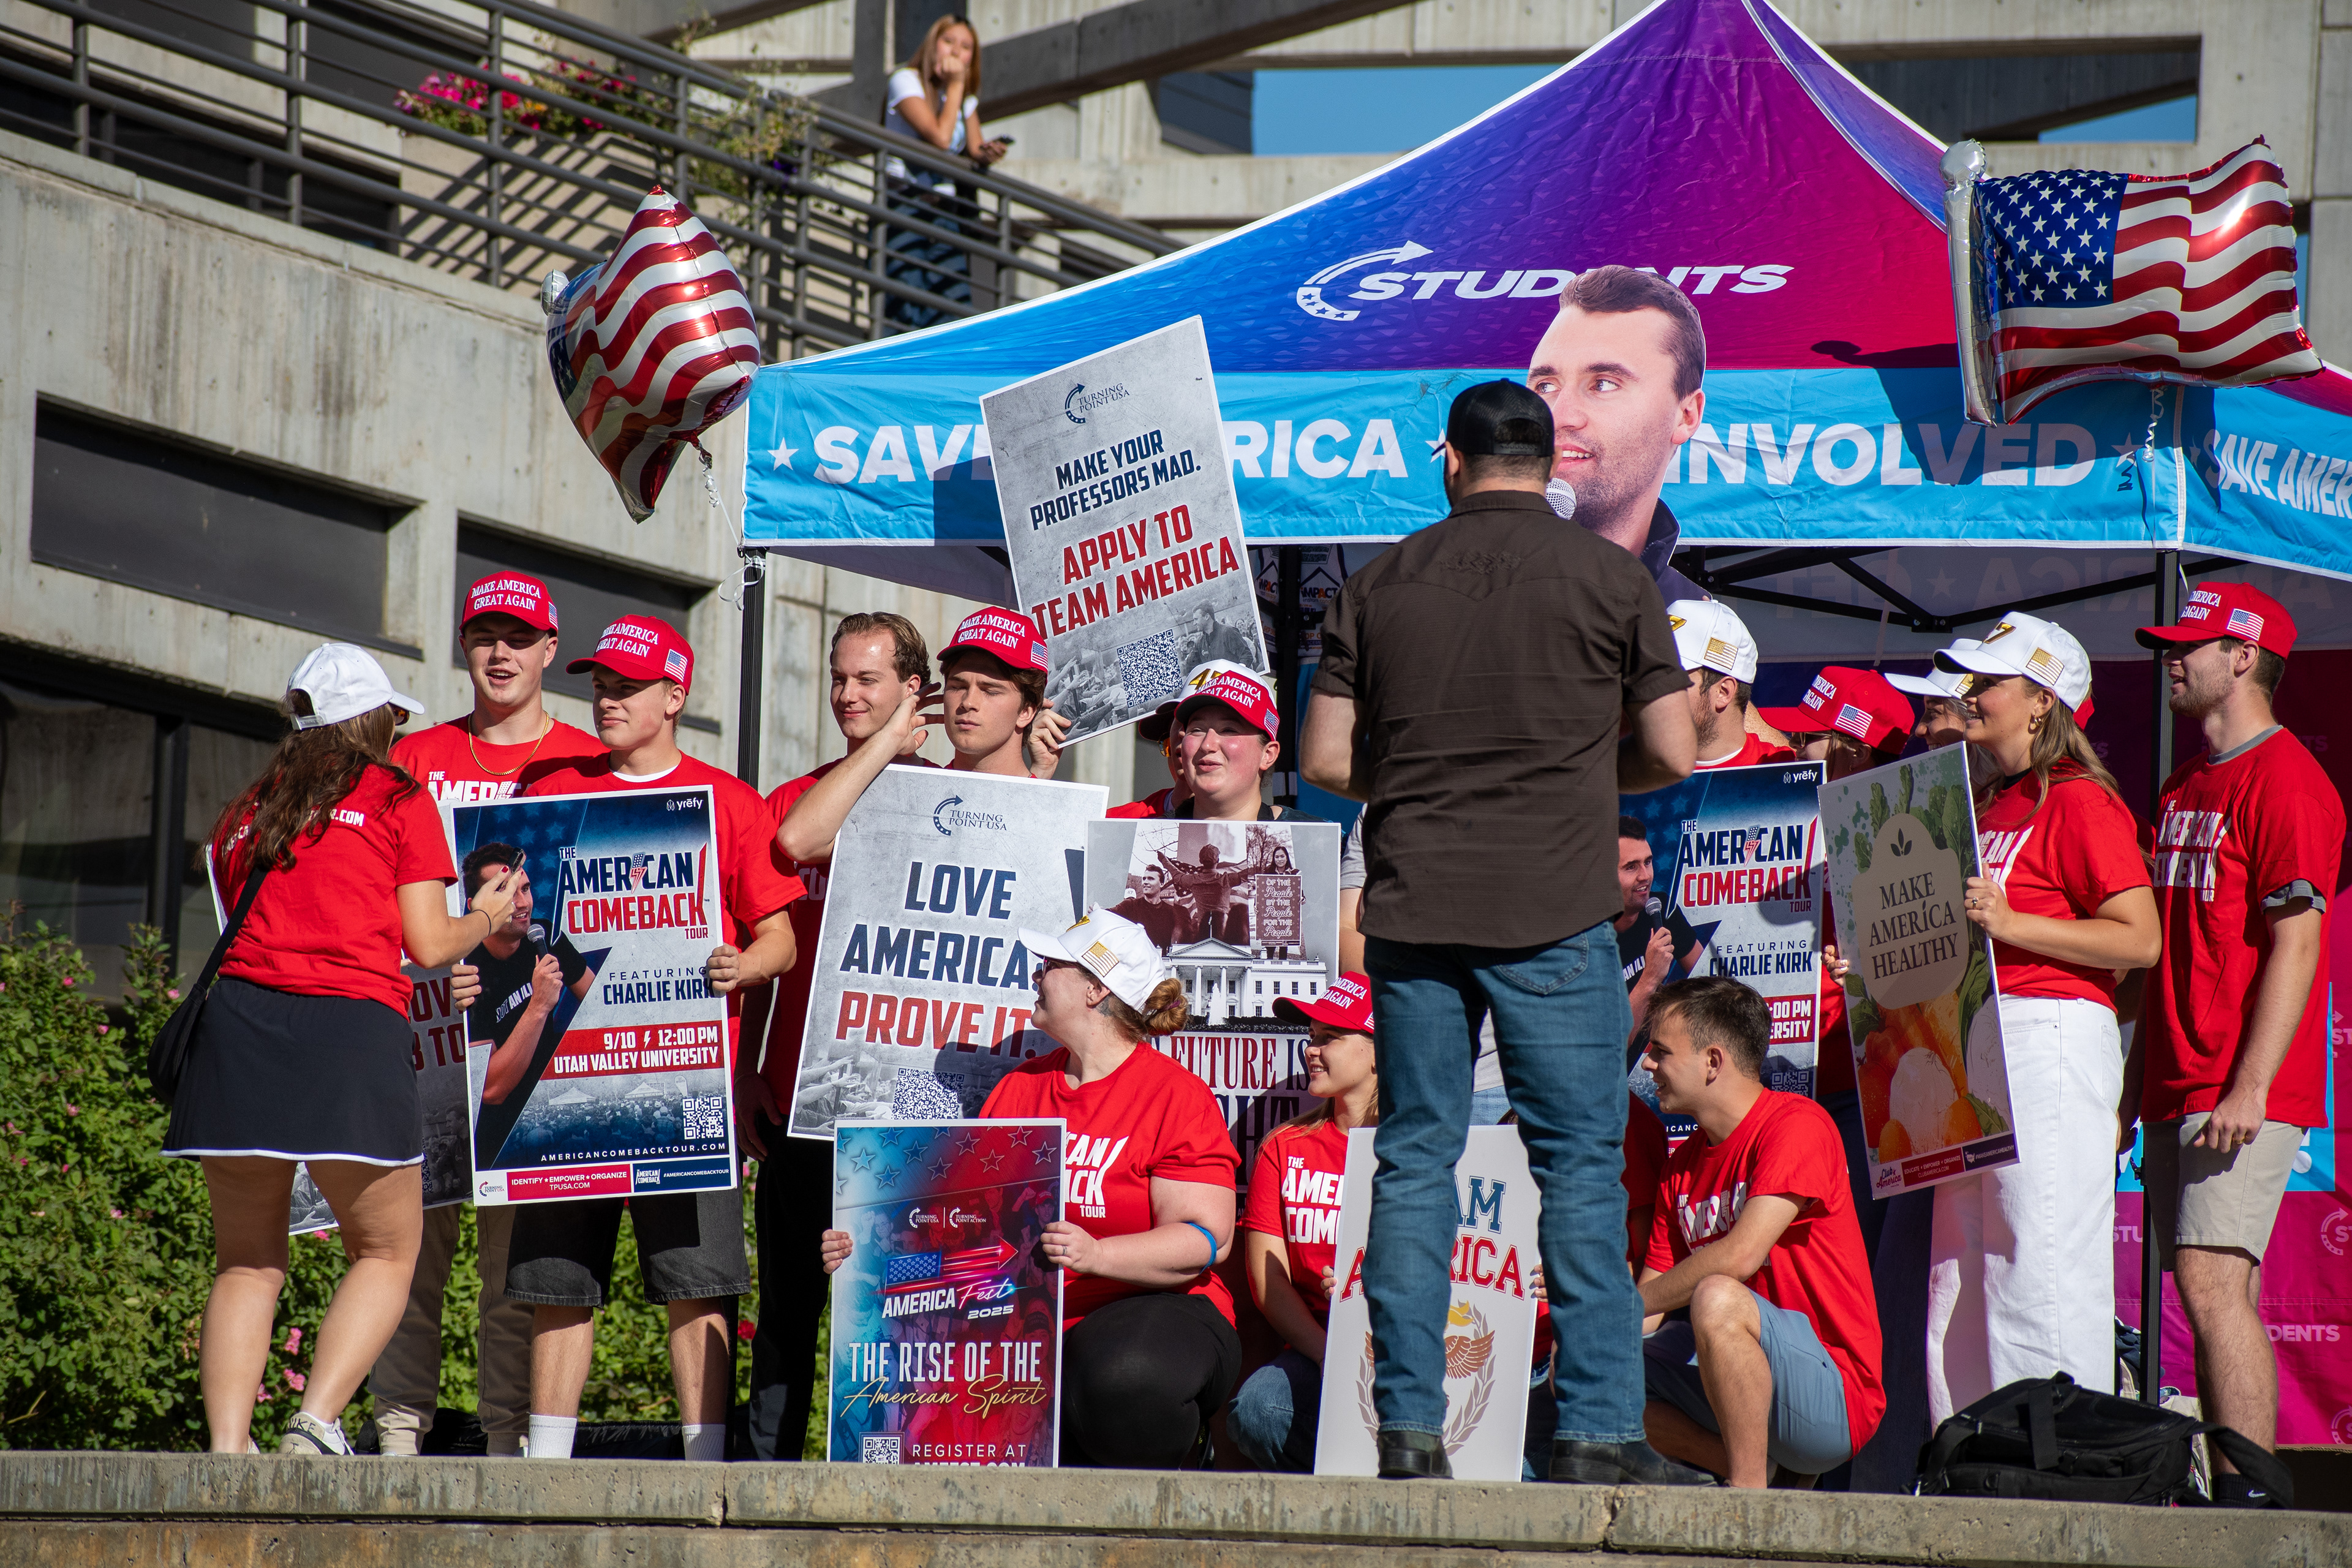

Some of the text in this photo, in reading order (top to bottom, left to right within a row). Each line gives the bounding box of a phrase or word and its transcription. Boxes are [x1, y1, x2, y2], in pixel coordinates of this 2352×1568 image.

[1348, 265, 1794, 301] STUDTS
[1077, 383, 1123, 405] TURNING
[1079, 389, 1130, 414] POINT USA
[1222, 418, 1408, 479] RICA
[1055, 429, 1164, 490] MAKE YOUR
[2203, 429, 2278, 501] SAVE
[1030, 449, 1201, 531] PROFESSORS MAD.
[1064, 505, 1193, 586] APPLY TO
[471, 579, 541, 599] MAKE AMERICA
[1031, 536, 1240, 640] TEAM AMERICA
[473, 594, 536, 611] GREAT AGAIN
[613, 624, 658, 645] AMERICA
[959, 614, 1025, 638] MAKE AMERICA
[616, 639, 650, 658] AGAIN
[958, 628, 1019, 649] GREAT AGAIN
[1216, 676, 1261, 701] AMERICA
[1223, 689, 1255, 709] AGAIN
[429, 771, 445, 781] THE
[948, 818, 1007, 831] POINT USA
[950, 810, 1003, 823] TURNING
[1681, 820, 1697, 832] THE
[560, 846, 576, 859] THE
[905, 861, 1017, 920] LOVE
[1264, 886, 1294, 900] People
[1880, 872, 1936, 910] MAKE
[1264, 906, 1293, 919] People
[1790, 900, 1812, 913] TOUR
[685, 927, 709, 940] TOUR
[1264, 925, 1293, 939] People
[1869, 900, 1957, 948] AMERICA
[1716, 940, 1807, 954] FEATURING
[1872, 933, 1959, 980] HEALTHY
[609, 966, 707, 981] FEATURING
[1709, 952, 1812, 977] CHARLIE KIRK
[508, 990, 522, 1010] AN
[603, 980, 671, 1005] CHARLIE
[1324, 990, 1354, 1009] AGAIN
[1790, 998, 1811, 1017] PM
[835, 990, 1038, 1060] PROVE IT.
[1770, 1020, 1811, 1041] ERSITY
[604, 1026, 718, 1050] 9/10 12:00 PM
[554, 1046, 718, 1074] UTAH VALLEY UNIVERSITY
[541, 1143, 726, 1162] AMERICANCOMEBACKTOUR.COM
[1288, 1156, 1304, 1169] THE
[1975, 1144, 2015, 1161] #MAKEAMERICAHEALTHY
[663, 1169, 729, 1178] #AMERICANCOMEBACKTOUR
[1882, 1166, 1893, 1180] Club
[1904, 1155, 1961, 1175] EDUCATE EMPOWER ORGANIZE
[1918, 1166, 1950, 1178] CLUBAMERICA.COM
[511, 1171, 627, 1186] IDENTIFY EMPOWER ORGANIZE
[549, 1182, 590, 1191] TPUSA.COM
[1876, 1174, 1902, 1189] America
[1080, 1205, 1106, 1218] TOUR
[882, 1278, 1014, 1318] AMERICA Fest
[967, 1305, 1014, 1319] 2025
[2266, 1324, 2340, 1343] DENTS
[849, 1341, 1042, 1383] THE RISE OF THE
[840, 1374, 1047, 1419] American Spirit
[913, 1444, 1026, 1457] REGISTER AT
